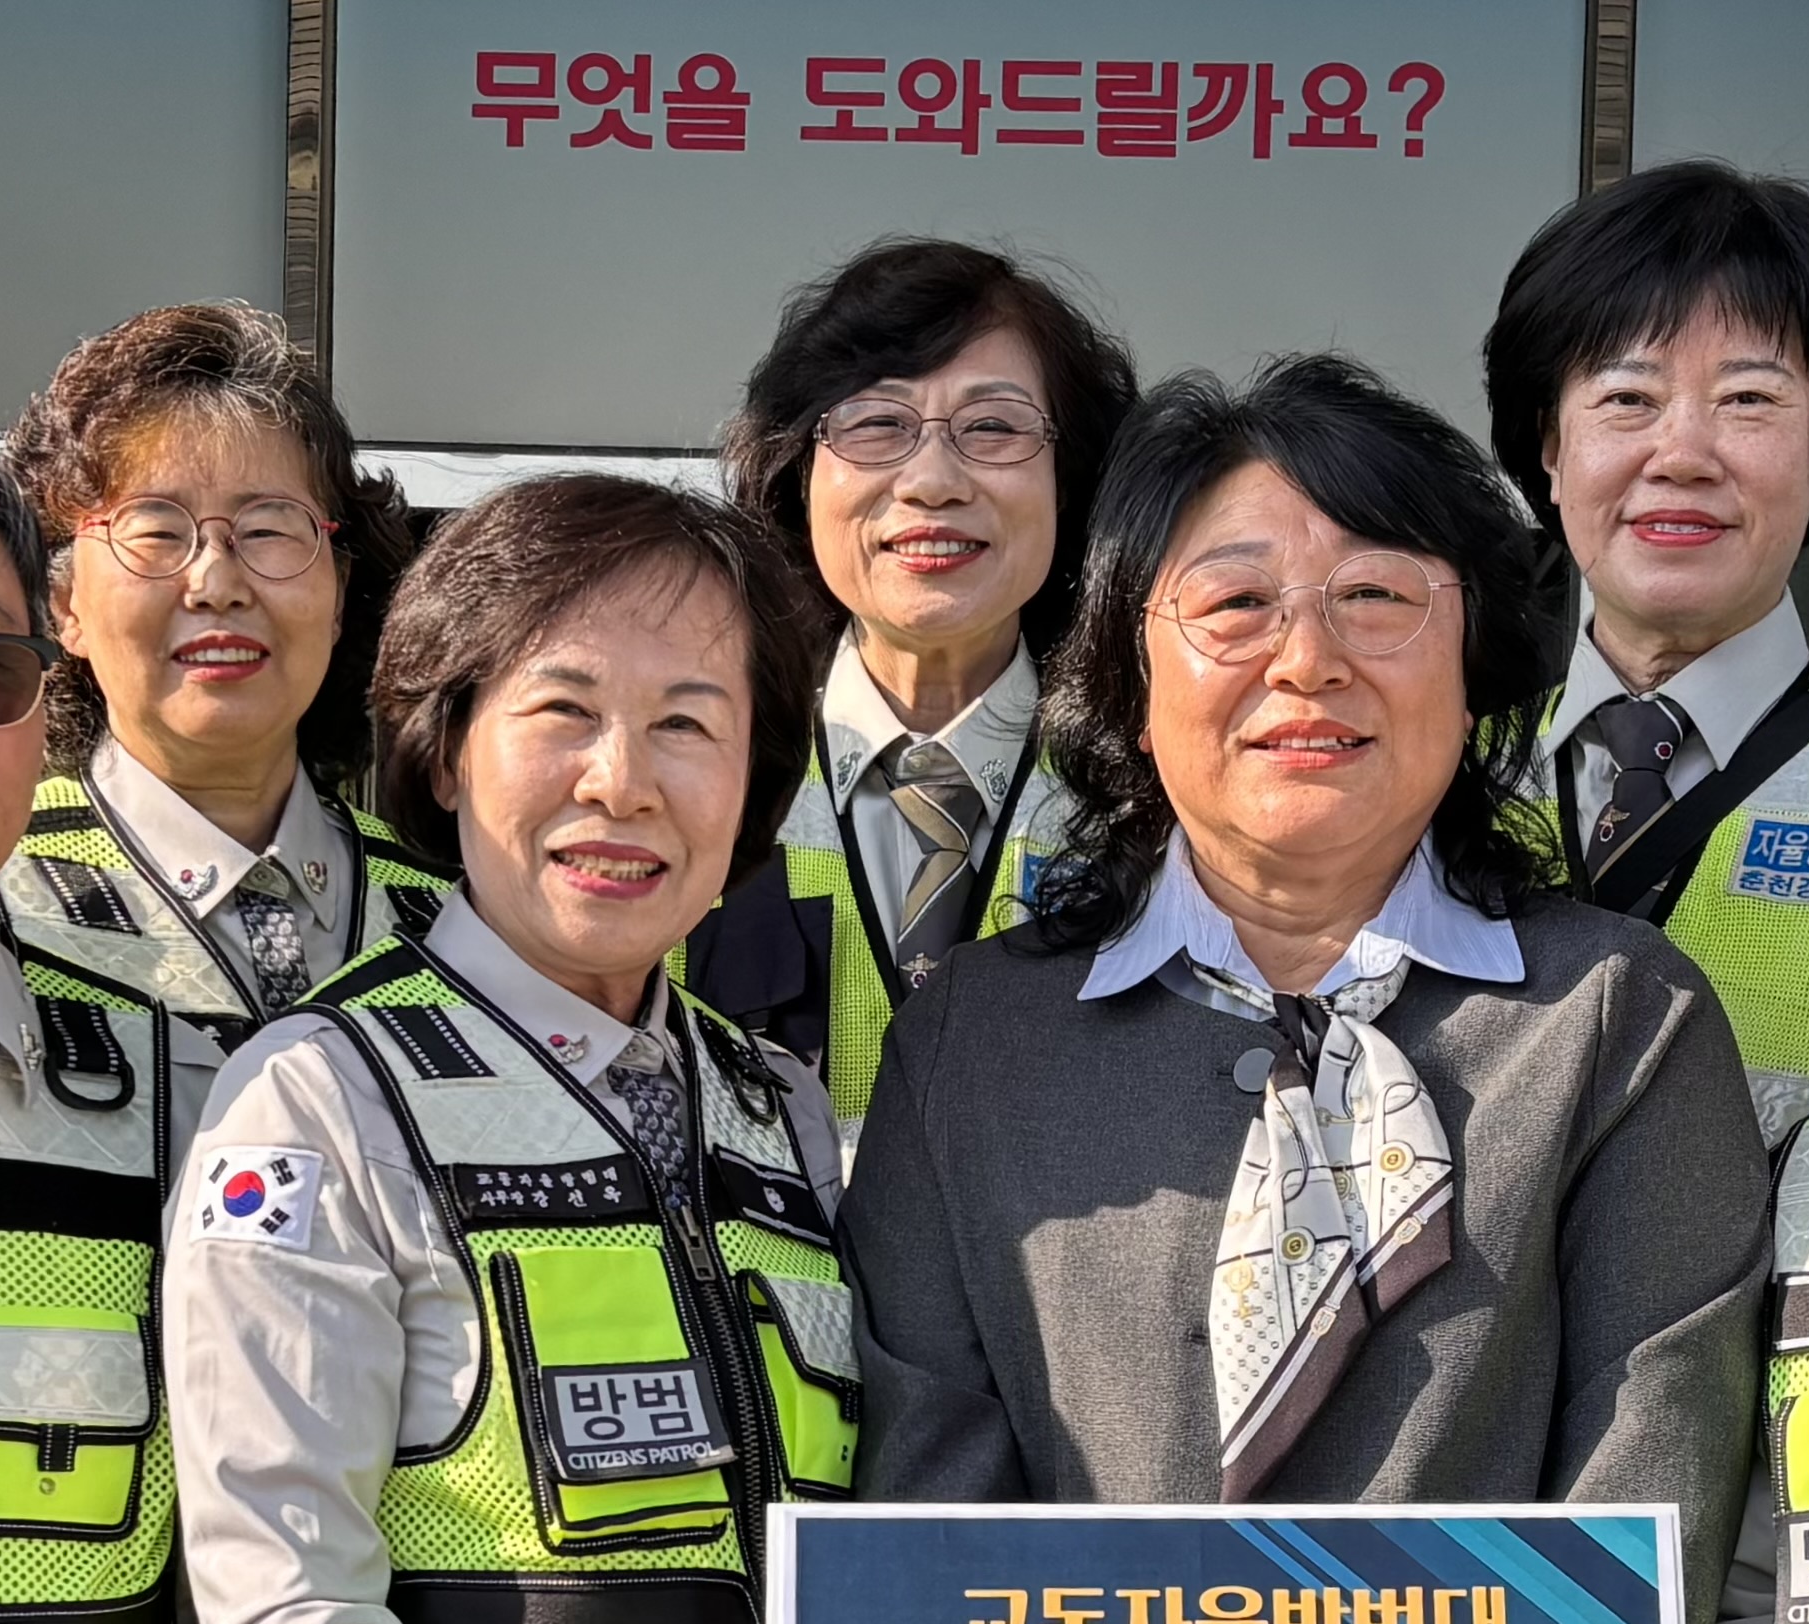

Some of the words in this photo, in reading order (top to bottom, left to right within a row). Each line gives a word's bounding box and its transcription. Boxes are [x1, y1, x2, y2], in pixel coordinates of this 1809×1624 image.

[472, 52, 751, 152] 무엇을
[800, 58, 1445, 158] 도와드릴까요?
[568, 1374, 695, 1441] 방범
[567, 1448, 648, 1471] CITIZENS
[648, 1440, 722, 1465] PATROL
